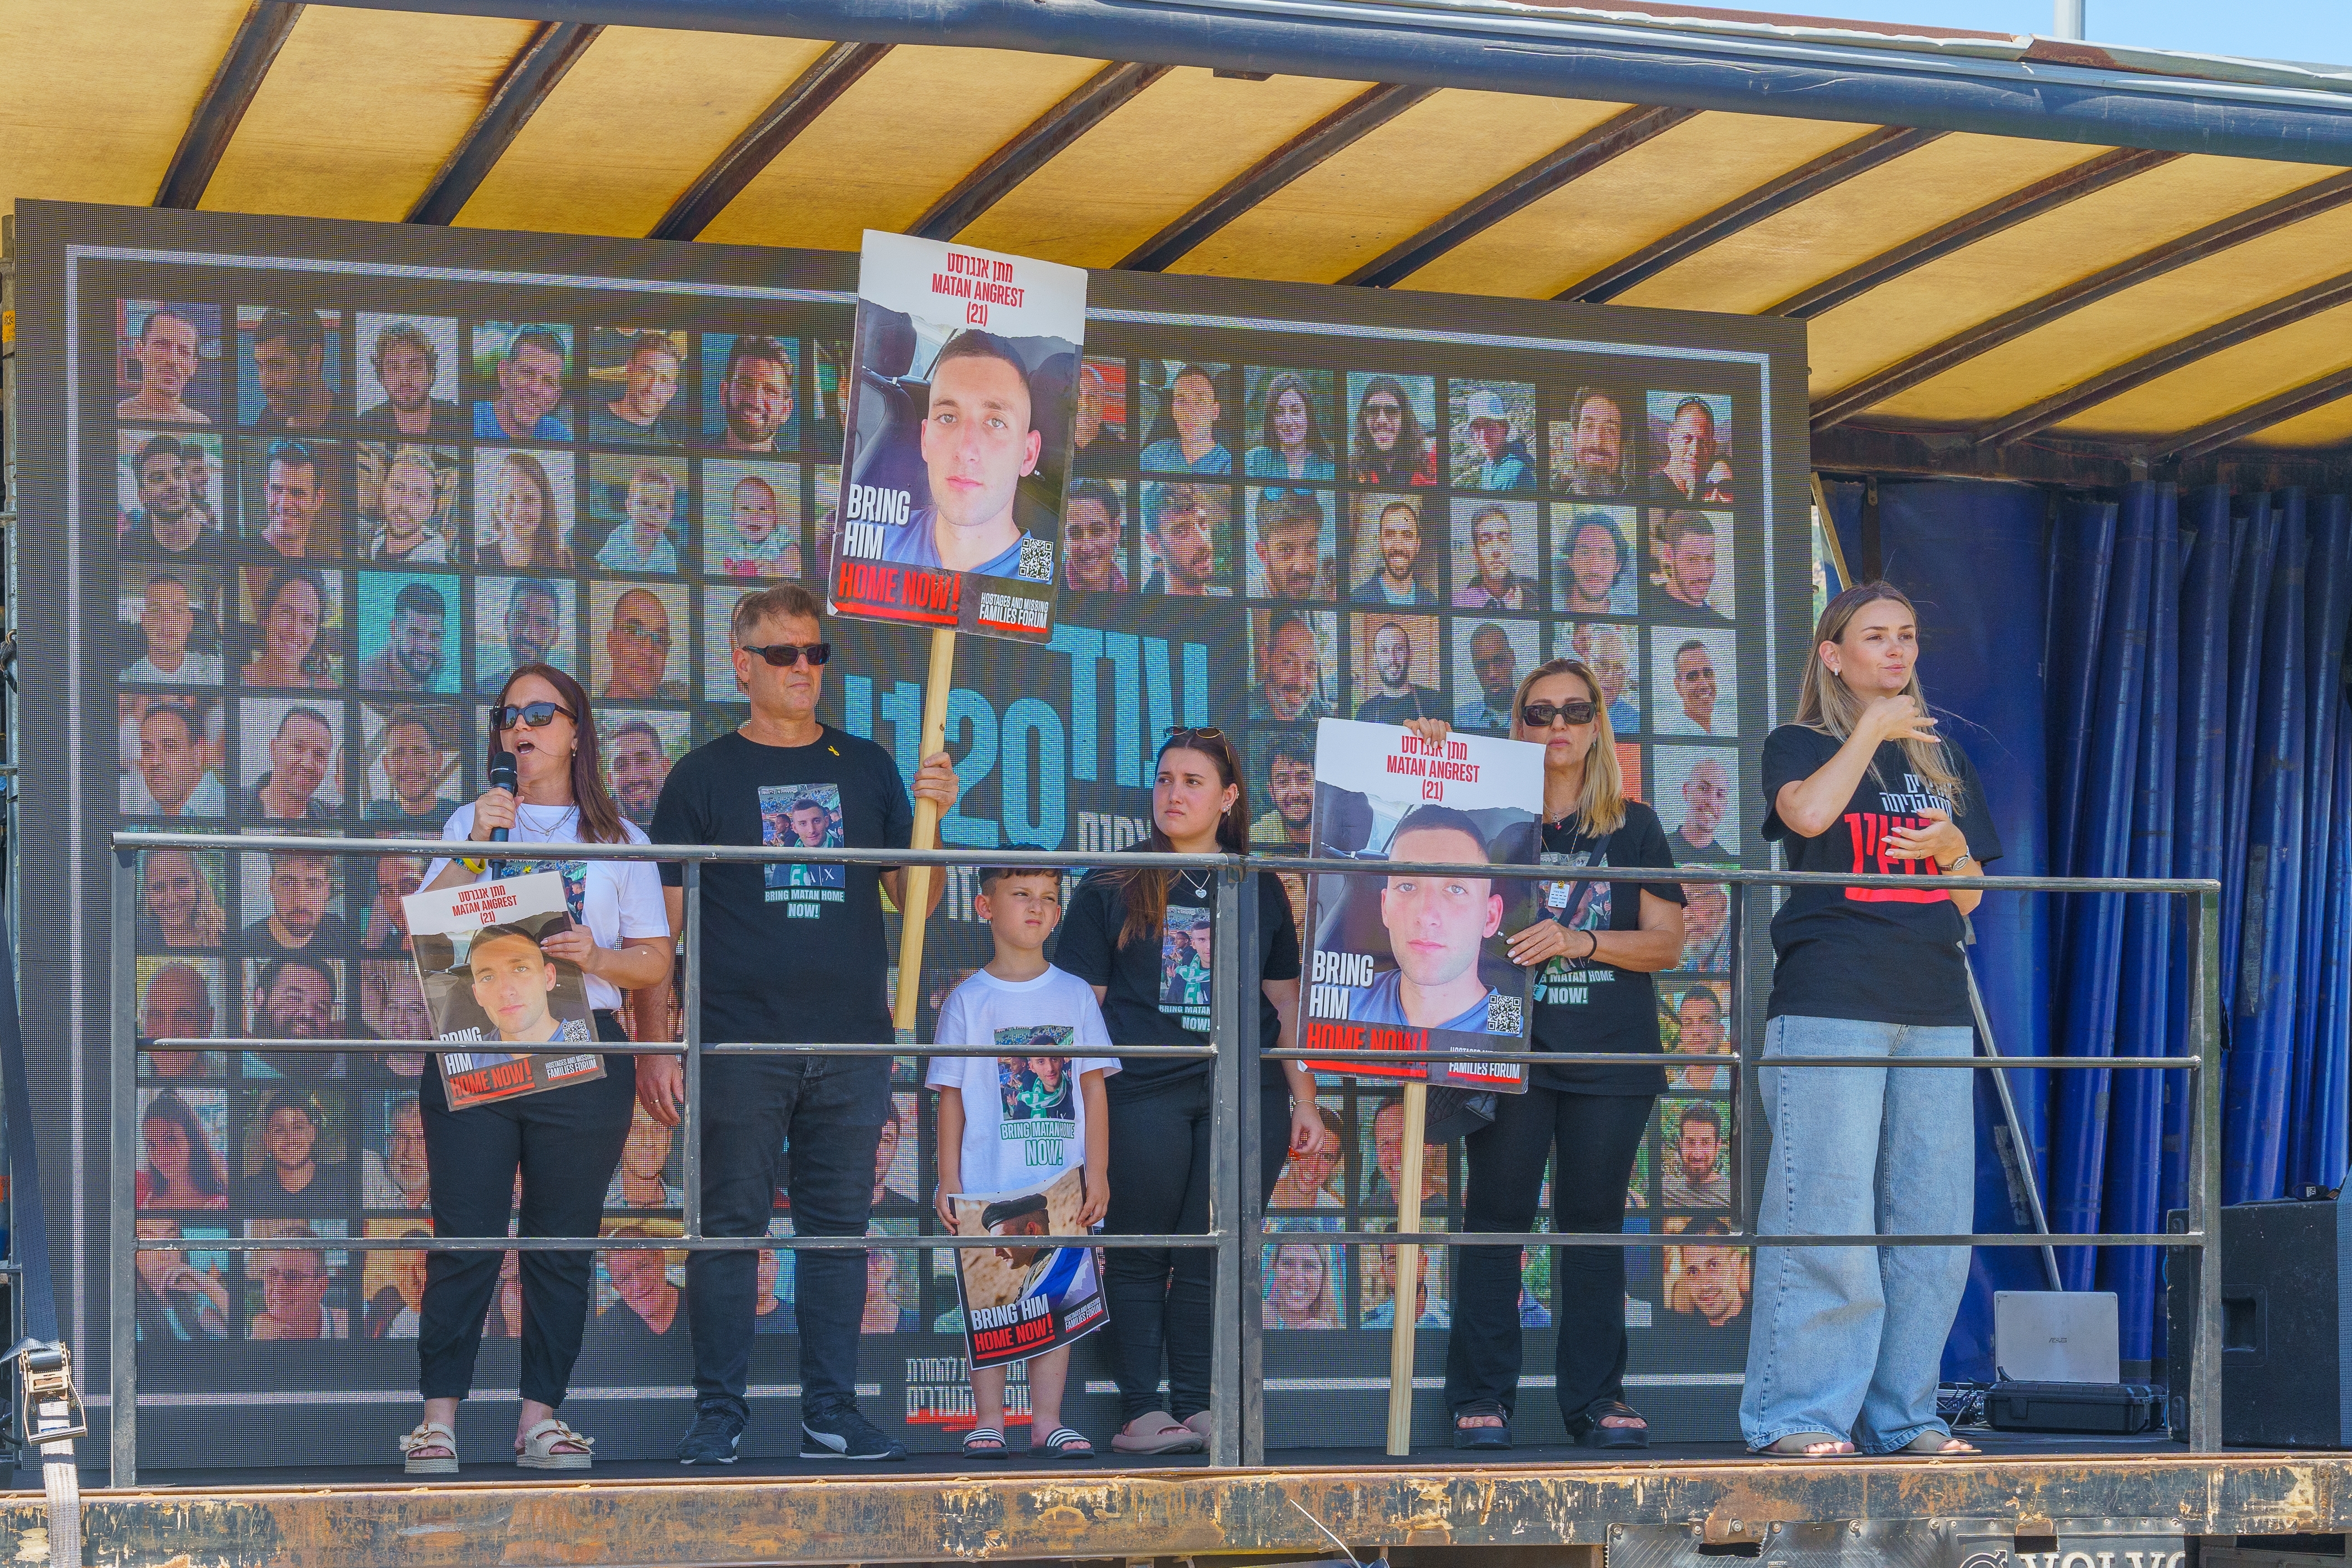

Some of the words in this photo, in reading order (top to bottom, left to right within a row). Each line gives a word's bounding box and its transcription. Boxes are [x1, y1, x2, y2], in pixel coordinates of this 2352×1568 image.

[947, 252, 989, 279] אנגרסט
[993, 261, 1013, 283] מתן
[932, 273, 971, 298] MATAN
[974, 281, 1024, 307] ANGREST
[966, 301, 988, 326] (21)
[847, 484, 911, 525] BRING
[842, 521, 885, 560] HIM
[838, 562, 897, 603] HOME
[902, 570, 961, 612] NOW!
[981, 592, 1011, 608] HOSTAGES
[1011, 596, 1023, 609] AND
[1024, 599, 1049, 613] MISSING
[979, 604, 1017, 624] FAMILIES
[1017, 610, 1047, 628] FORUM
[1447, 741, 1467, 760] מתן
[1387, 755, 1426, 776] MATAN
[1429, 760, 1480, 783] ANGREST
[1422, 779, 1443, 802] (21)
[458, 888, 489, 902] אנגרסט
[489, 885, 506, 898] מתן
[766, 891, 788, 901] BRING
[791, 890, 820, 900] MATAN
[821, 891, 844, 901] HOME
[452, 902, 480, 916] MATAN
[482, 895, 517, 911] ANGREST
[788, 904, 820, 918] NOW!
[480, 911, 495, 925] (21)
[1311, 950, 1373, 987] BRING
[1550, 971, 1586, 983] MATAN
[1588, 970, 1614, 982] HOME
[1309, 985, 1349, 1020] HIM
[1549, 987, 1587, 1004] NOW!
[1159, 1005, 1183, 1013] BRING
[445, 1053, 473, 1075] HIM
[545, 1058, 567, 1069] HOSTAGES
[547, 1064, 574, 1079] FAMILIES
[574, 1059, 597, 1073] FORUM
[1449, 1062, 1488, 1075] FAMILIES
[1490, 1063, 1520, 1079] FORUM
[450, 1069, 490, 1097] HOME
[491, 1059, 532, 1088] NOW!
[1001, 1122, 1030, 1139] BRING
[1031, 1121, 1060, 1137] MATAN
[1060, 1122, 1075, 1139] HOME
[1025, 1139, 1063, 1165] NOW!
[971, 1303, 1018, 1331] BRING
[1021, 1293, 1049, 1321] HIM
[1064, 1309, 1081, 1322] HOSTAGES
[1065, 1313, 1086, 1331] FAMILIES
[1086, 1303, 1102, 1319] FORUM
[974, 1327, 1014, 1352] HOME
[1015, 1313, 1053, 1344] NOW!
